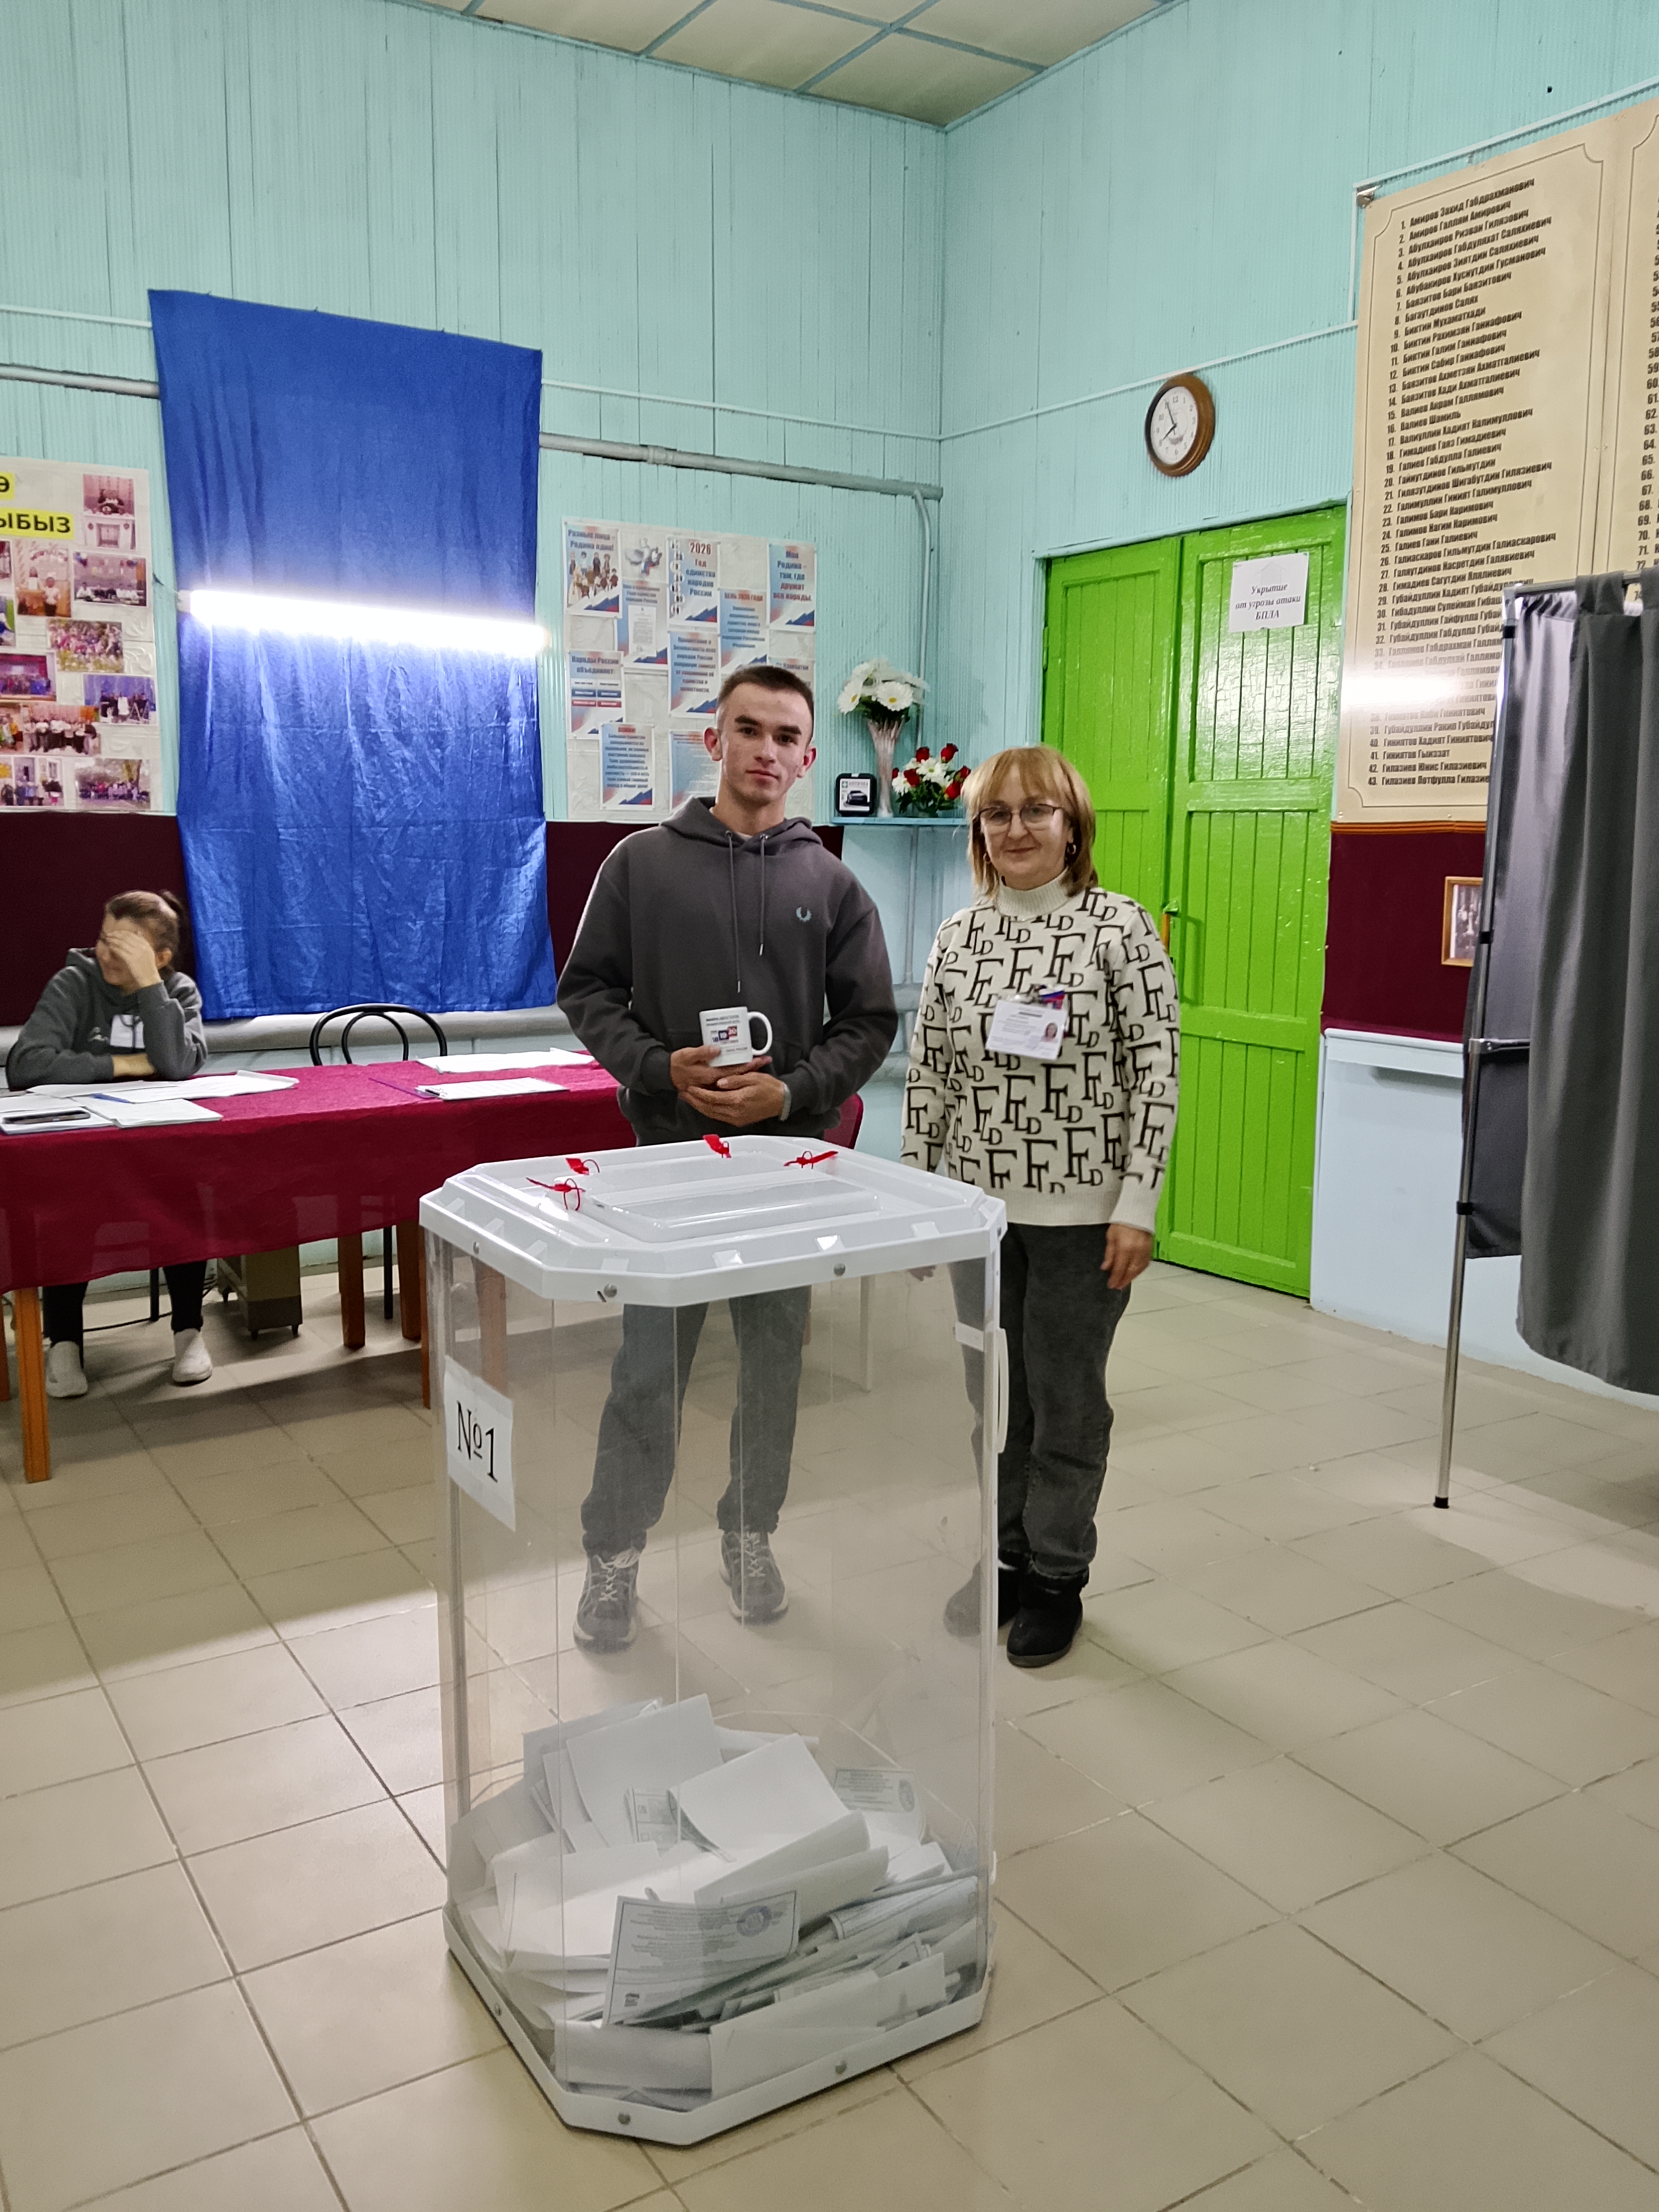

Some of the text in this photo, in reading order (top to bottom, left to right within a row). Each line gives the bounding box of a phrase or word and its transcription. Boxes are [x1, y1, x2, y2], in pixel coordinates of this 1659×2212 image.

[1401, 220, 1406, 230] 1.
[1399, 234, 1405, 245] 2.
[1398, 247, 1405, 258] 3.
[1398, 261, 1404, 271] 4.
[1397, 275, 1403, 285] 5.
[1395, 288, 1402, 299] 6.
[1397, 301, 1401, 312] 7.
[1394, 315, 1401, 326] 8.
[1394, 329, 1400, 340] 9.
[1404, 322, 1432, 336] Биктин
[1390, 342, 1399, 354] 10.
[1404, 335, 1431, 350] Биктин
[1402, 349, 1431, 364] Биктин
[1390, 369, 1398, 381] 12.
[1402, 363, 1430, 377] Биктин
[1388, 396, 1397, 407] 14.
[1387, 423, 1395, 434] 16.
[1386, 463, 1394, 474] 19.
[1384, 477, 1393, 488] 20.
[1384, 490, 1394, 501] 21.
[1383, 503, 1393, 515] 22.
[1381, 530, 1392, 541] 24.
[570, 541, 595, 549] Родина
[690, 542, 711, 555] 2026
[1380, 543, 1391, 554] 25.
[777, 561, 801, 569] Родина
[1380, 556, 1391, 567] 26.
[686, 569, 716, 577] единства
[687, 579, 713, 588] народов
[1378, 583, 1389, 593] 28.
[690, 589, 712, 597] России
[1251, 584, 1288, 596] Укрытие
[1248, 599, 1273, 610] угрозы
[1276, 596, 1301, 605] атаки
[1256, 610, 1279, 620] БПЛА
[1368, 764, 1379, 773] 42.
[456, 1400, 498, 1482] №1
